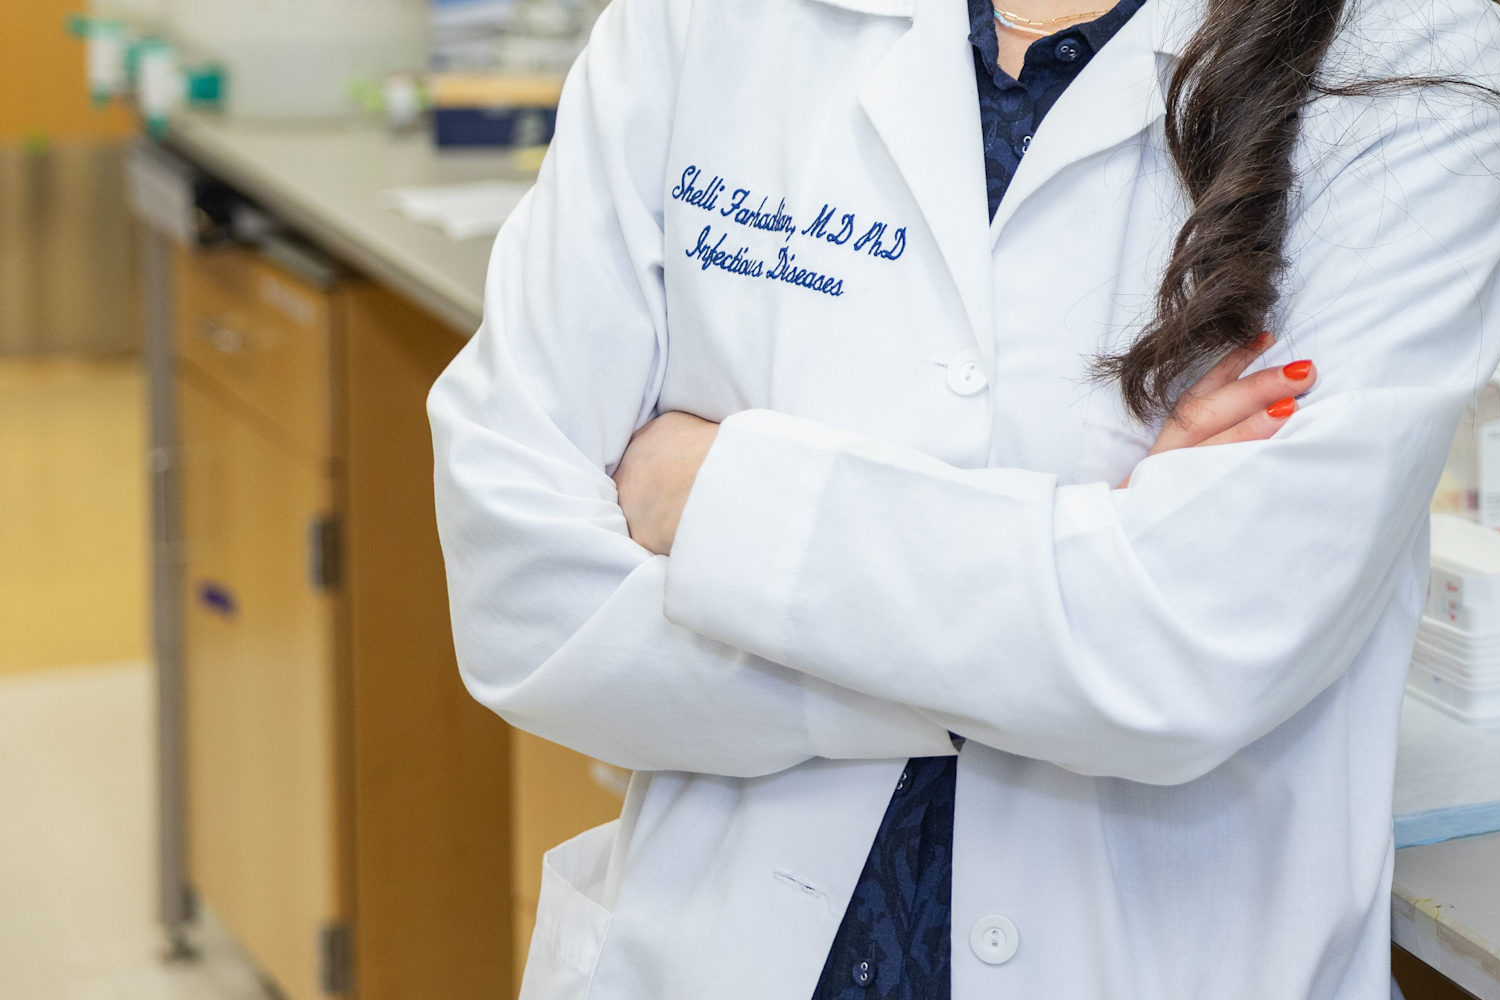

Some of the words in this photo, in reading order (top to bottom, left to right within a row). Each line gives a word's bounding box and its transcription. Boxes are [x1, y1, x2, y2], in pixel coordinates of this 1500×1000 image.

[671, 164, 726, 211] Shelli
[853, 220, 907, 261] PhD
[685, 224, 763, 278] Infectious
[766, 245, 844, 297] Diseases
